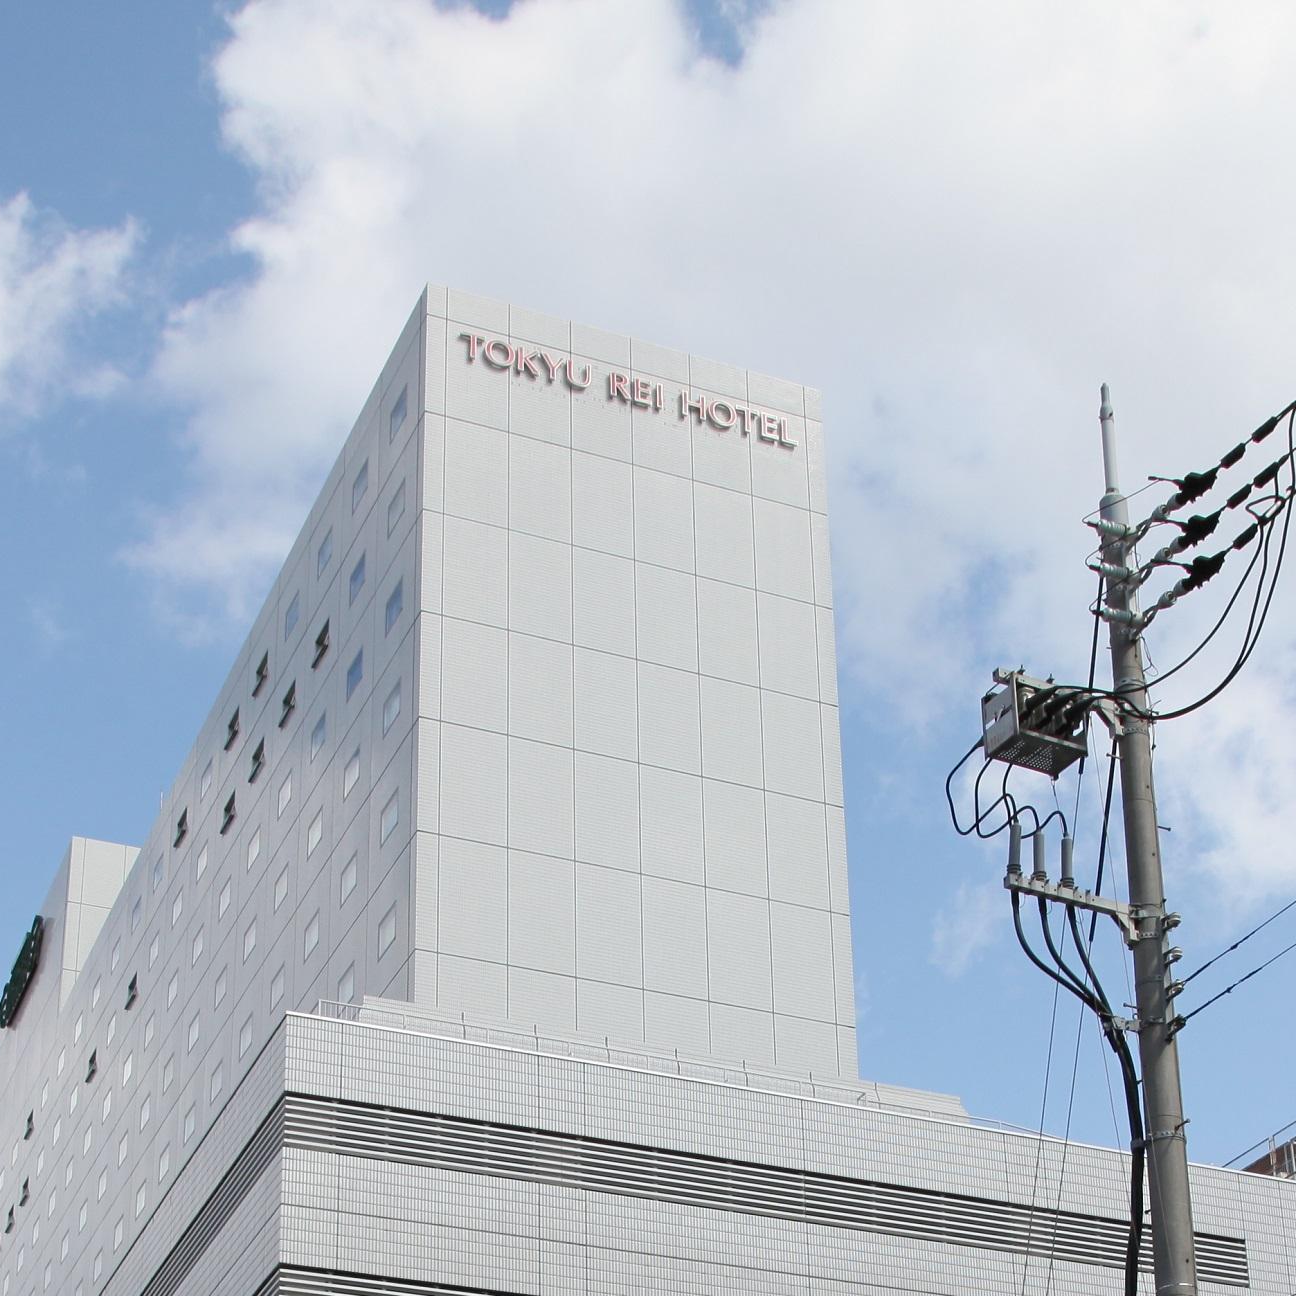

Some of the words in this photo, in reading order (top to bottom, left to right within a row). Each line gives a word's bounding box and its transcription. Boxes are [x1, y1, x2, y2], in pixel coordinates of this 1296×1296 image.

[459, 332, 593, 390] TOKYU
[609, 371, 664, 411] REI
[681, 389, 800, 448] HOTEL
